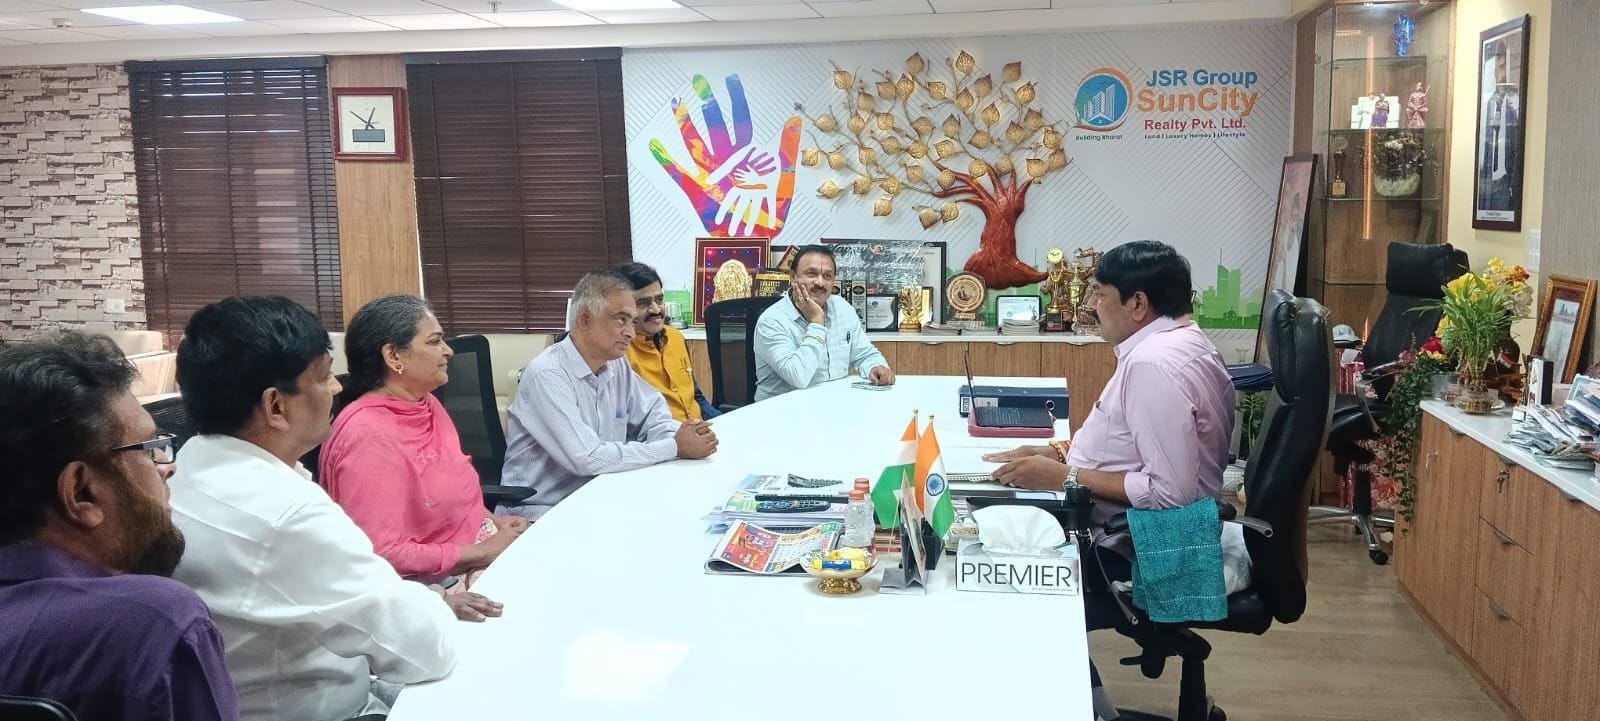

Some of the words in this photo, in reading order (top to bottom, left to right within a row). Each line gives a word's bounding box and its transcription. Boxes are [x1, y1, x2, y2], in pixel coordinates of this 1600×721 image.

[1146, 69, 1186, 86] JSR
[1193, 69, 1258, 88] Group
[1137, 87, 1258, 117] SunCity
[1145, 119, 1187, 131] Realty
[1192, 118, 1216, 129] Pvt.
[1222, 117, 1246, 129] Ltd.
[961, 562, 1072, 587] PREMIER
